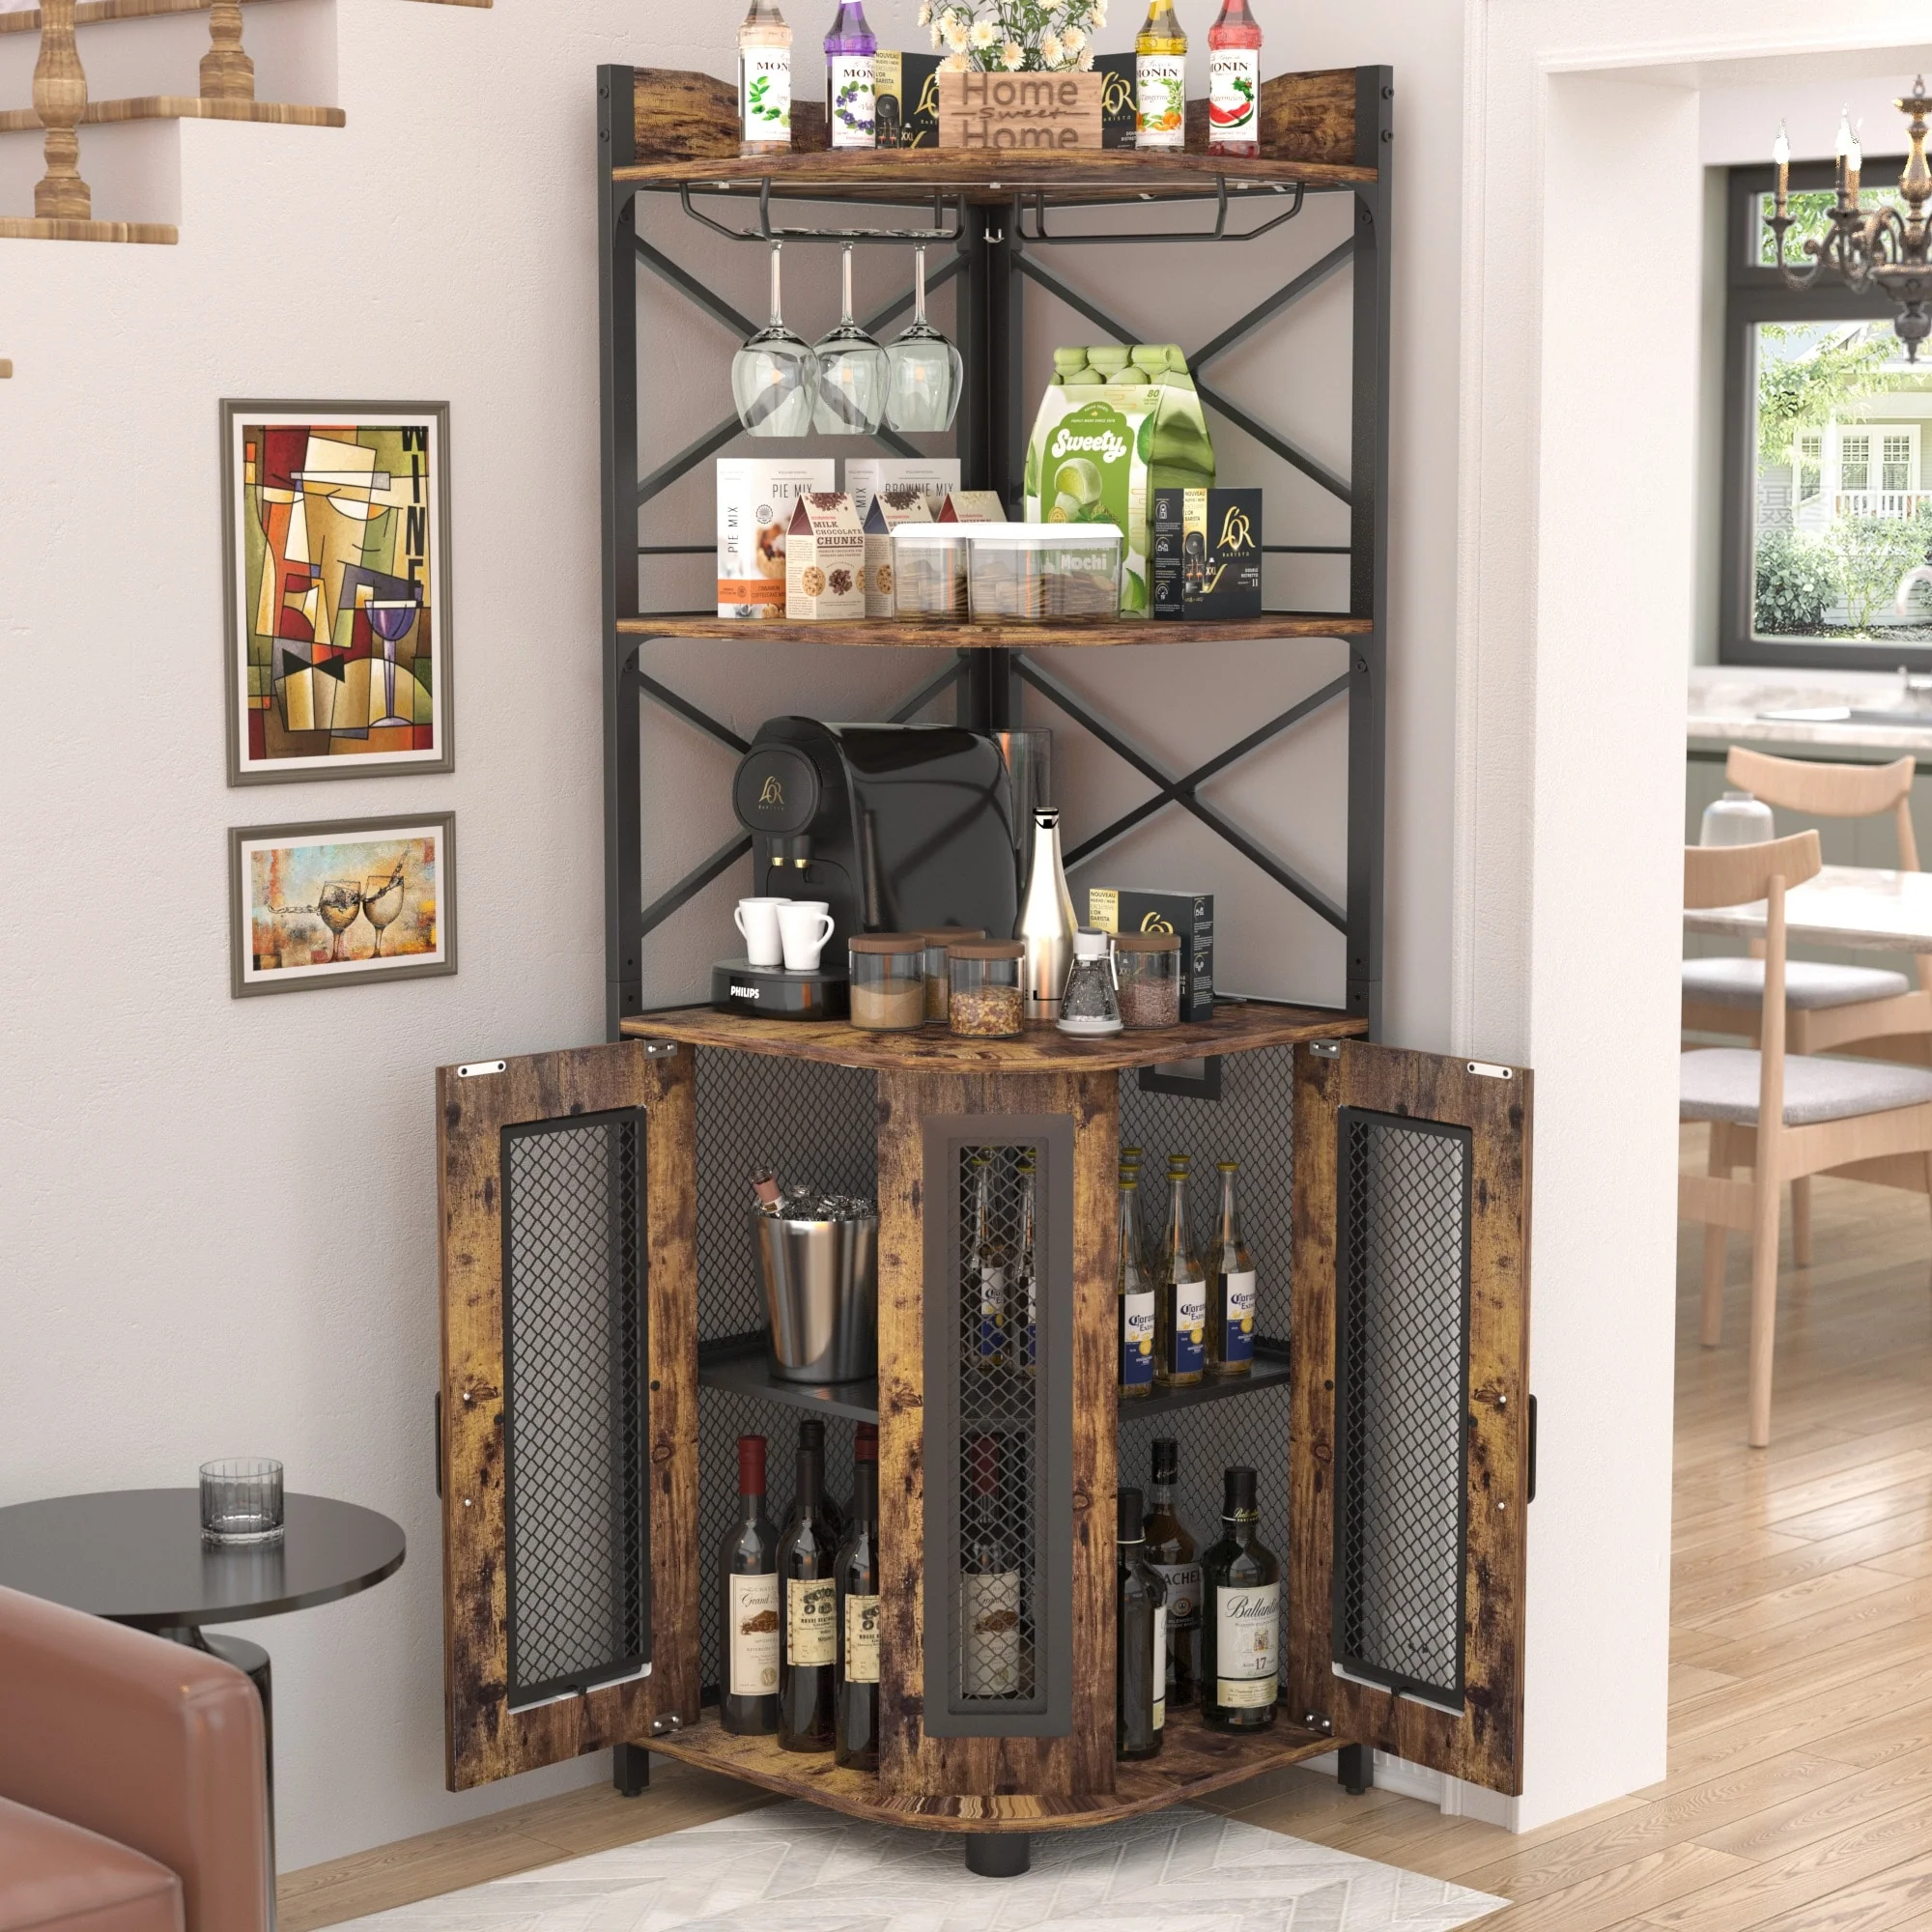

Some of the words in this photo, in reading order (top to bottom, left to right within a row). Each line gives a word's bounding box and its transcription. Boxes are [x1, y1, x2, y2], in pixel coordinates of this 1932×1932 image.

[962, 72, 1079, 105] Home
[979, 106, 1065, 120] Sweet
[962, 119, 1080, 149] Home
[1147, 389, 1160, 398] 80
[1051, 428, 1127, 464] Sweety
[773, 484, 789, 498] PIE
[856, 487, 867, 508] MIX
[726, 506, 739, 527] MIX
[1217, 506, 1256, 551] L'OR
[726, 534, 739, 554] PIE
[816, 536, 864, 546] CHUNKS
[1061, 554, 1108, 571] Mochi
[1206, 566, 1217, 576] XXL
[758, 776, 785, 805] L'OR
[730, 985, 760, 999] PHILIPS
[1256, 1657, 1267, 1670] 17
